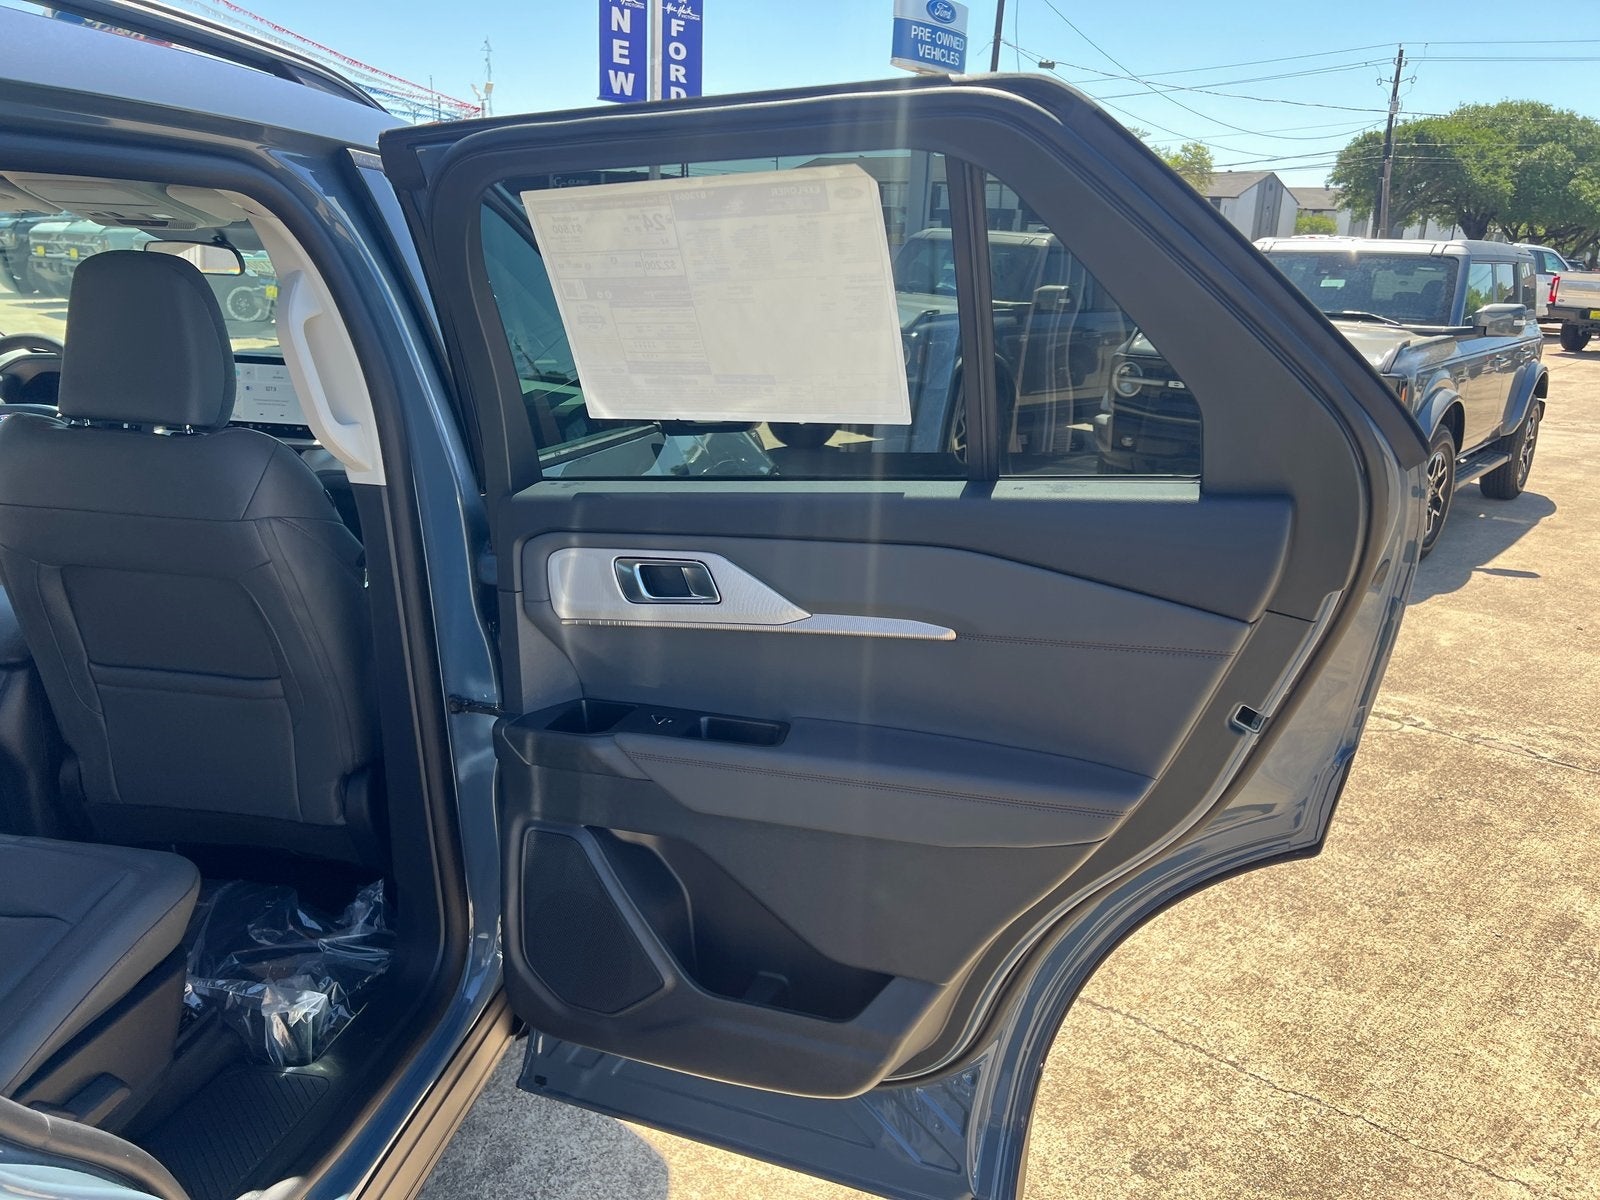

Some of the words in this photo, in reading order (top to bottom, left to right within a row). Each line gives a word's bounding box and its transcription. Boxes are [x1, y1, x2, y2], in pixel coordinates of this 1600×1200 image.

[934, 2, 952, 19] Ford
[608, 6, 635, 96] NEW
[918, 44, 959, 66] VEHICLES
